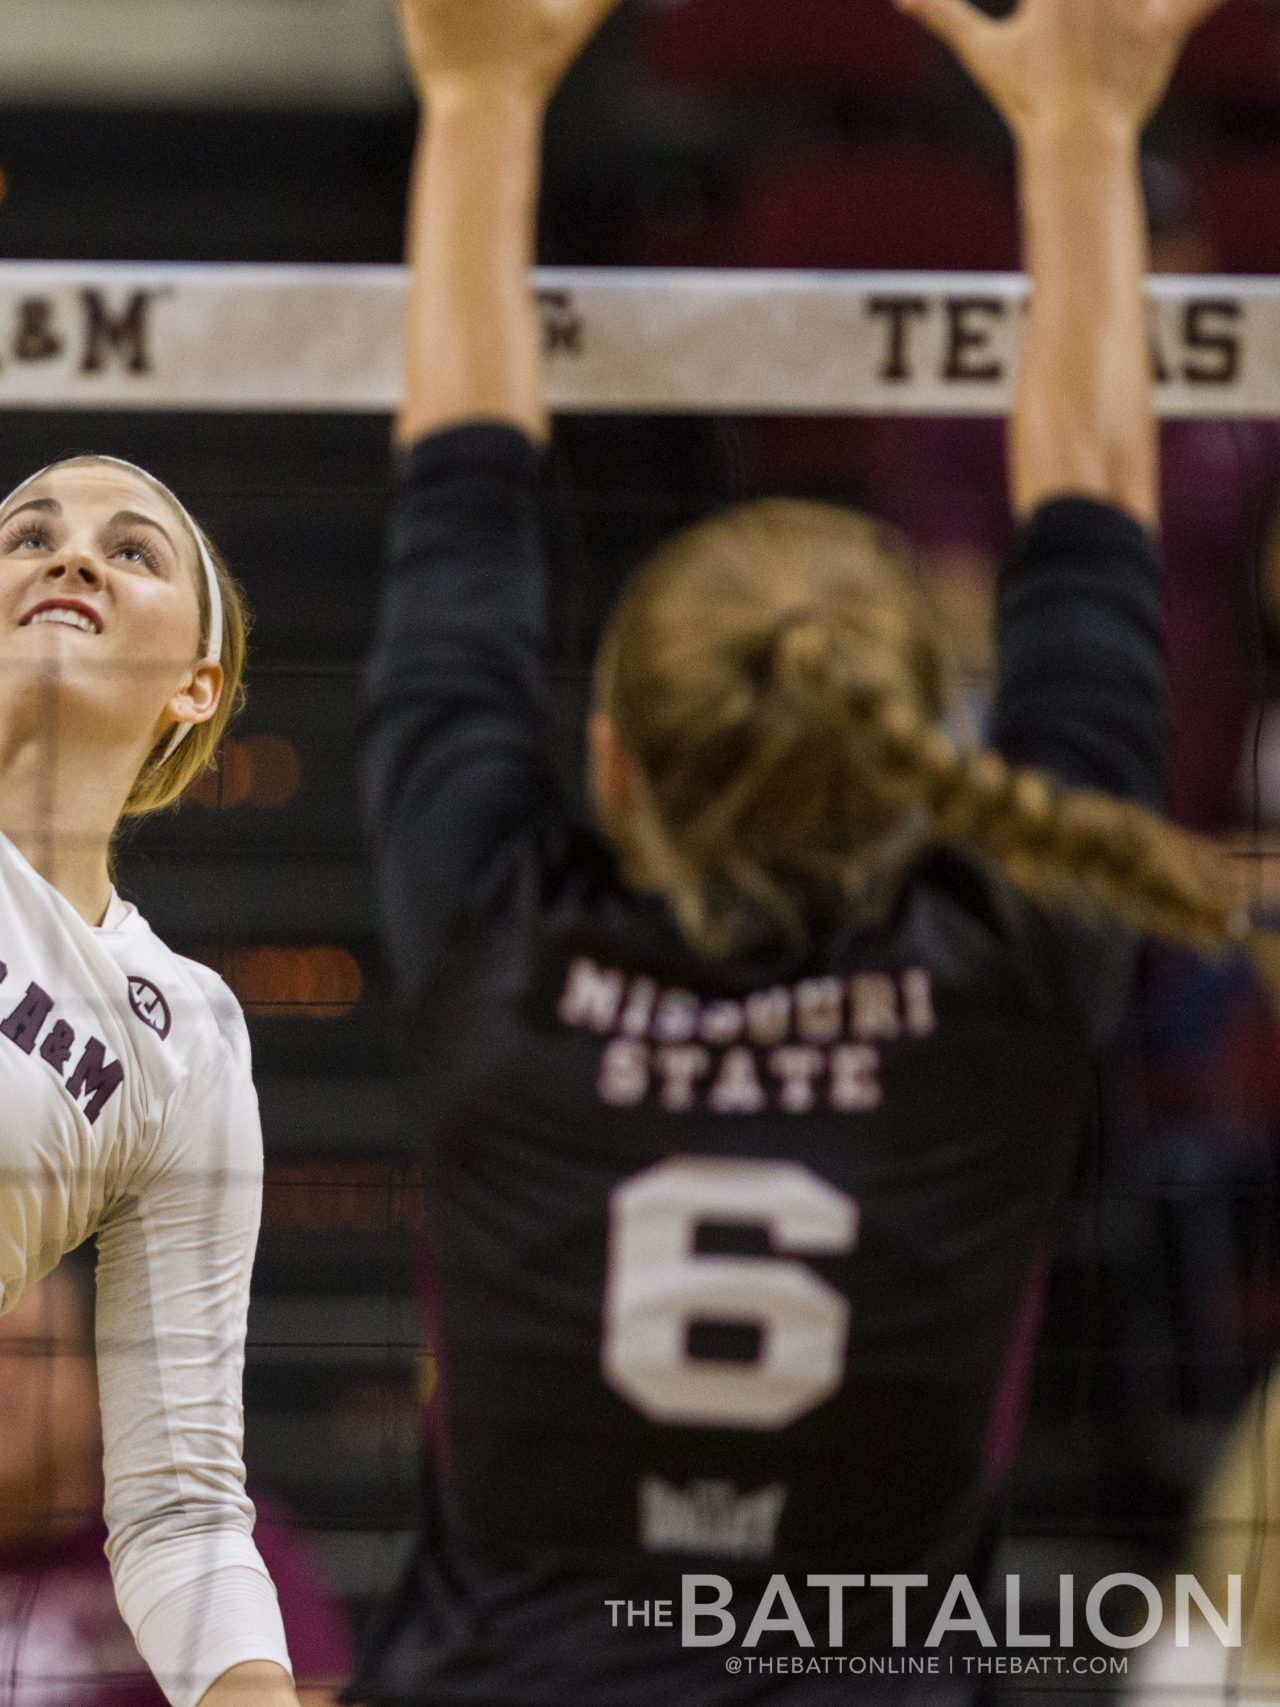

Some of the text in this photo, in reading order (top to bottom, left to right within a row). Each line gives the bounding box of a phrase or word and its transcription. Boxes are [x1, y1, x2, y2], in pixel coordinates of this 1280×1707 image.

[868, 297, 1244, 386] TES
[597, 1038, 883, 1114] STATE
[600, 1154, 861, 1431] 6
